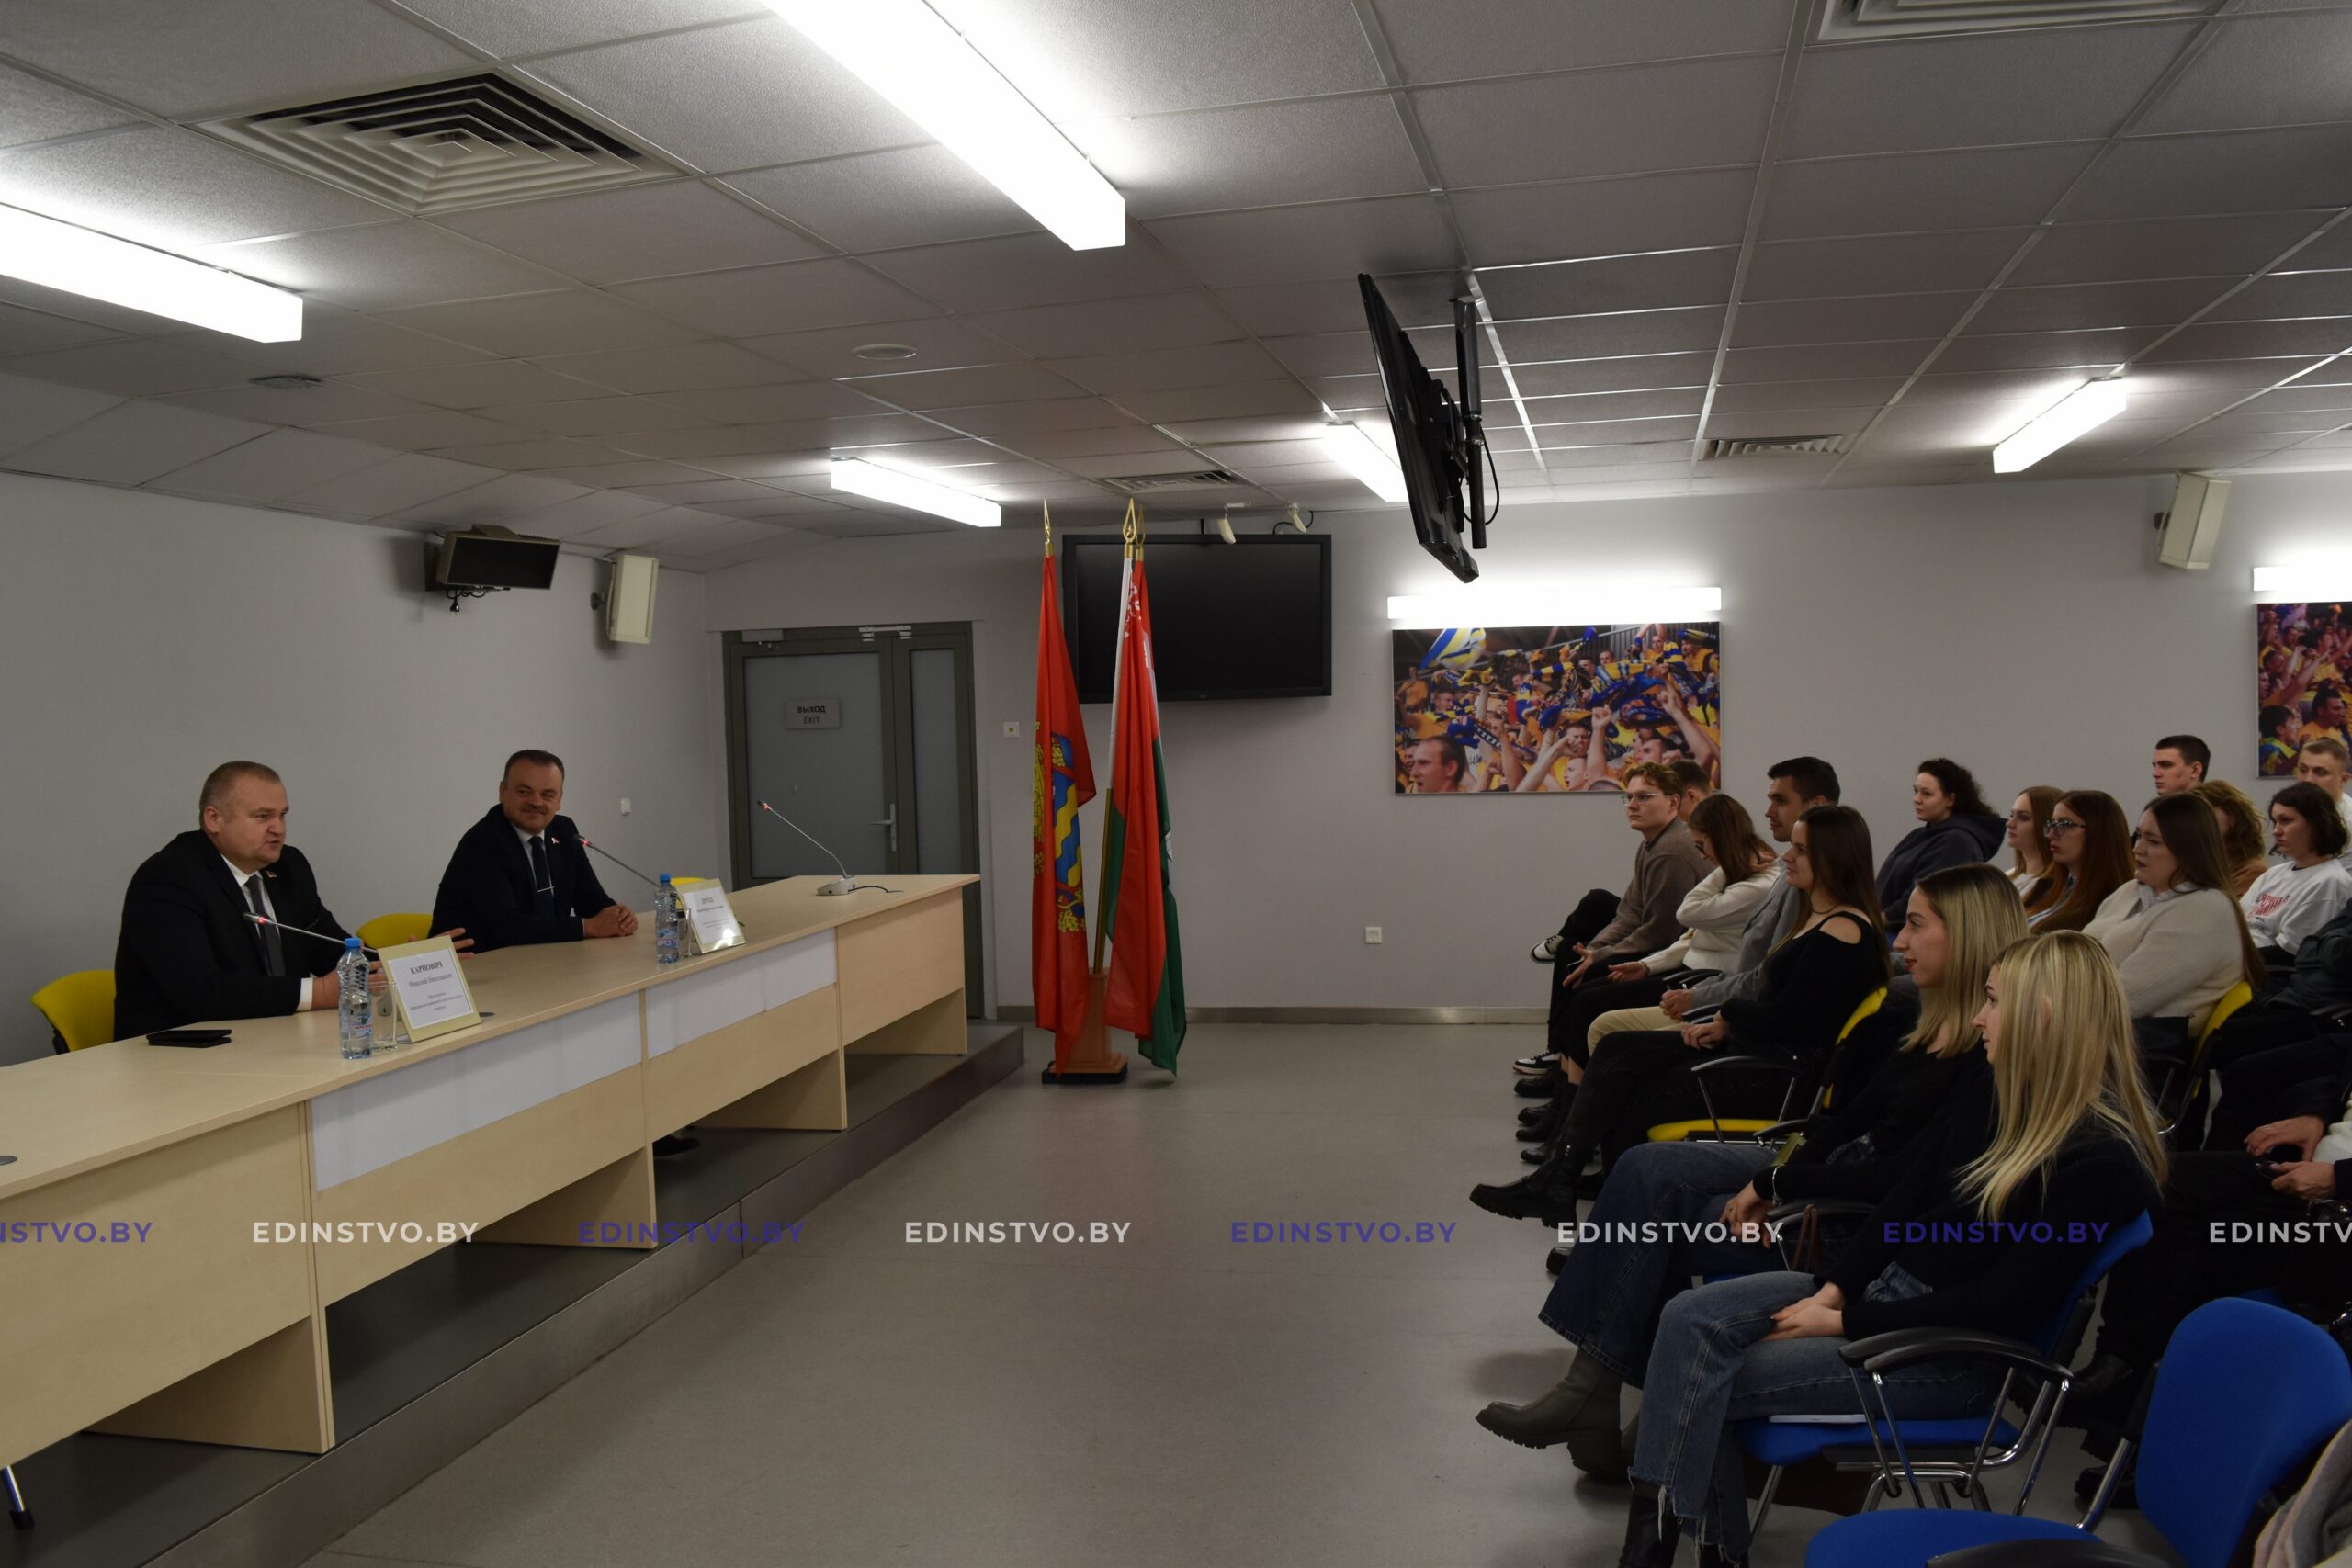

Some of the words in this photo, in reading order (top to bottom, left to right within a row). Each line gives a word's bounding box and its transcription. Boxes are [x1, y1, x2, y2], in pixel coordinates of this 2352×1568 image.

[797, 705, 826, 714] ВЫХОД
[803, 716, 820, 724] EXIT
[410, 961, 443, 975] КАРПОВИЧ
